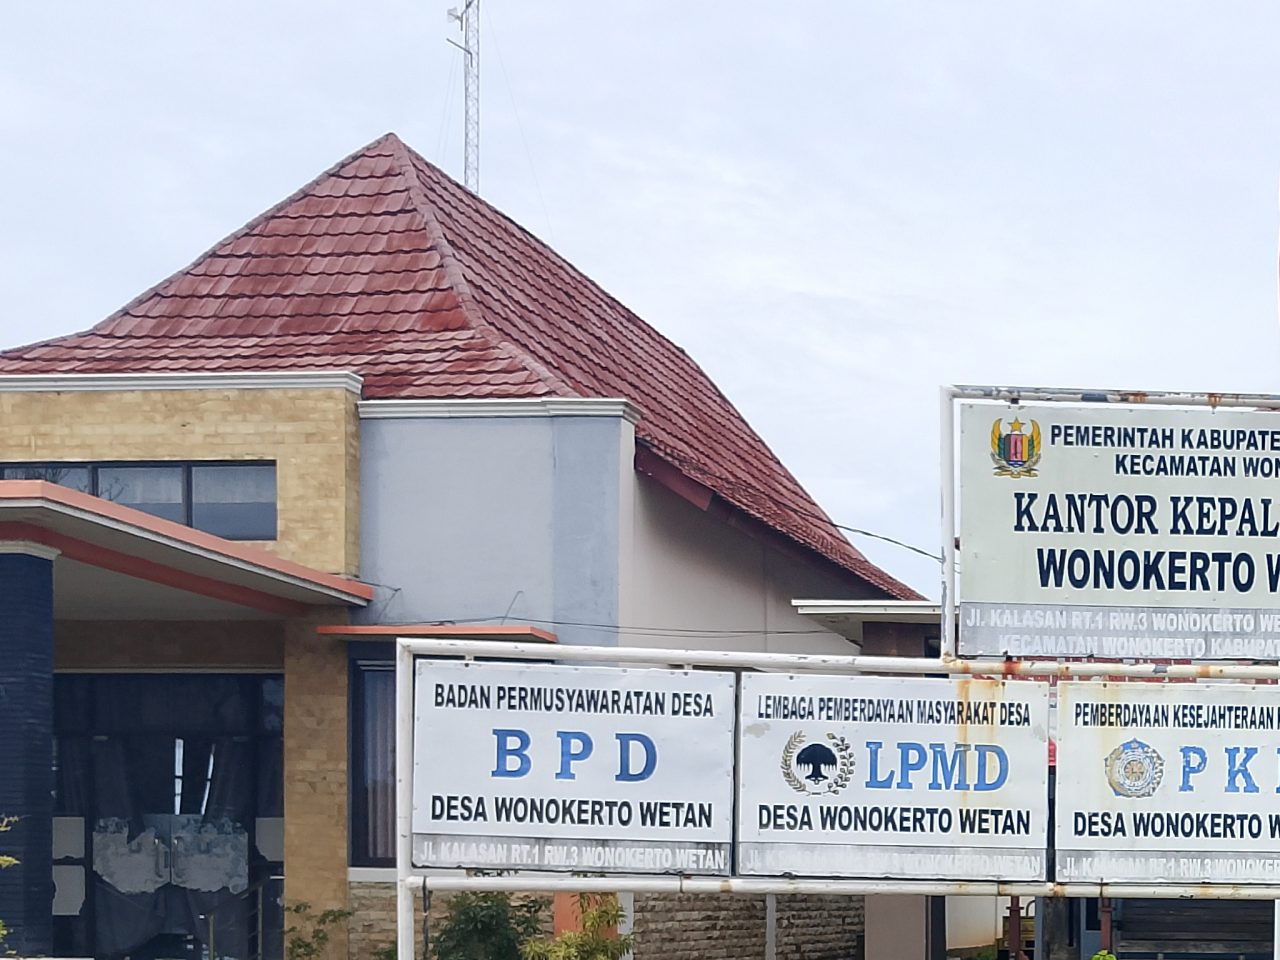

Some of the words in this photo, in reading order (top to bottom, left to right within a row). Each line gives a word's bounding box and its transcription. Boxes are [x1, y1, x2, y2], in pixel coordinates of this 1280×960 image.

[1051, 425, 1173, 448] PEMERINTAH
[1116, 454, 1235, 476] KECAMATAN
[1014, 493, 1158, 534] KANTOR
[1037, 549, 1254, 592] WONOKERTO
[991, 610, 1066, 629] KALASAN
[1152, 613, 1255, 633] WONOKERTO
[1000, 635, 1098, 656] KECAMATAN
[1102, 637, 1206, 658] WONOKERTO
[435, 684, 490, 708] BADAN
[497, 686, 665, 715] PERMUSYAWARATAN
[672, 693, 713, 716] DESA
[758, 696, 814, 719] LEMBAGA
[819, 698, 913, 722] PEMBERDAYAAN
[917, 700, 996, 725] MASYARAKAT
[1000, 703, 1030, 726] DESA
[1075, 703, 1168, 727] PEMBERDAYAAN
[1173, 705, 1273, 729] KESEJAHTERAAN
[865, 742, 1008, 791] LPMD
[432, 796, 487, 821] DESA
[495, 797, 632, 826] WONOKERTO
[640, 802, 711, 827] WETAN
[759, 805, 812, 830] DESA
[820, 806, 952, 832] WONOKERTO
[959, 809, 1030, 834] WETAN
[1074, 812, 1126, 836] DESA
[1133, 813, 1261, 838] WONOKERTO
[440, 842, 507, 863] KALASAN
[583, 846, 671, 867] WONOKERTO
[674, 849, 725, 870] WETAN
